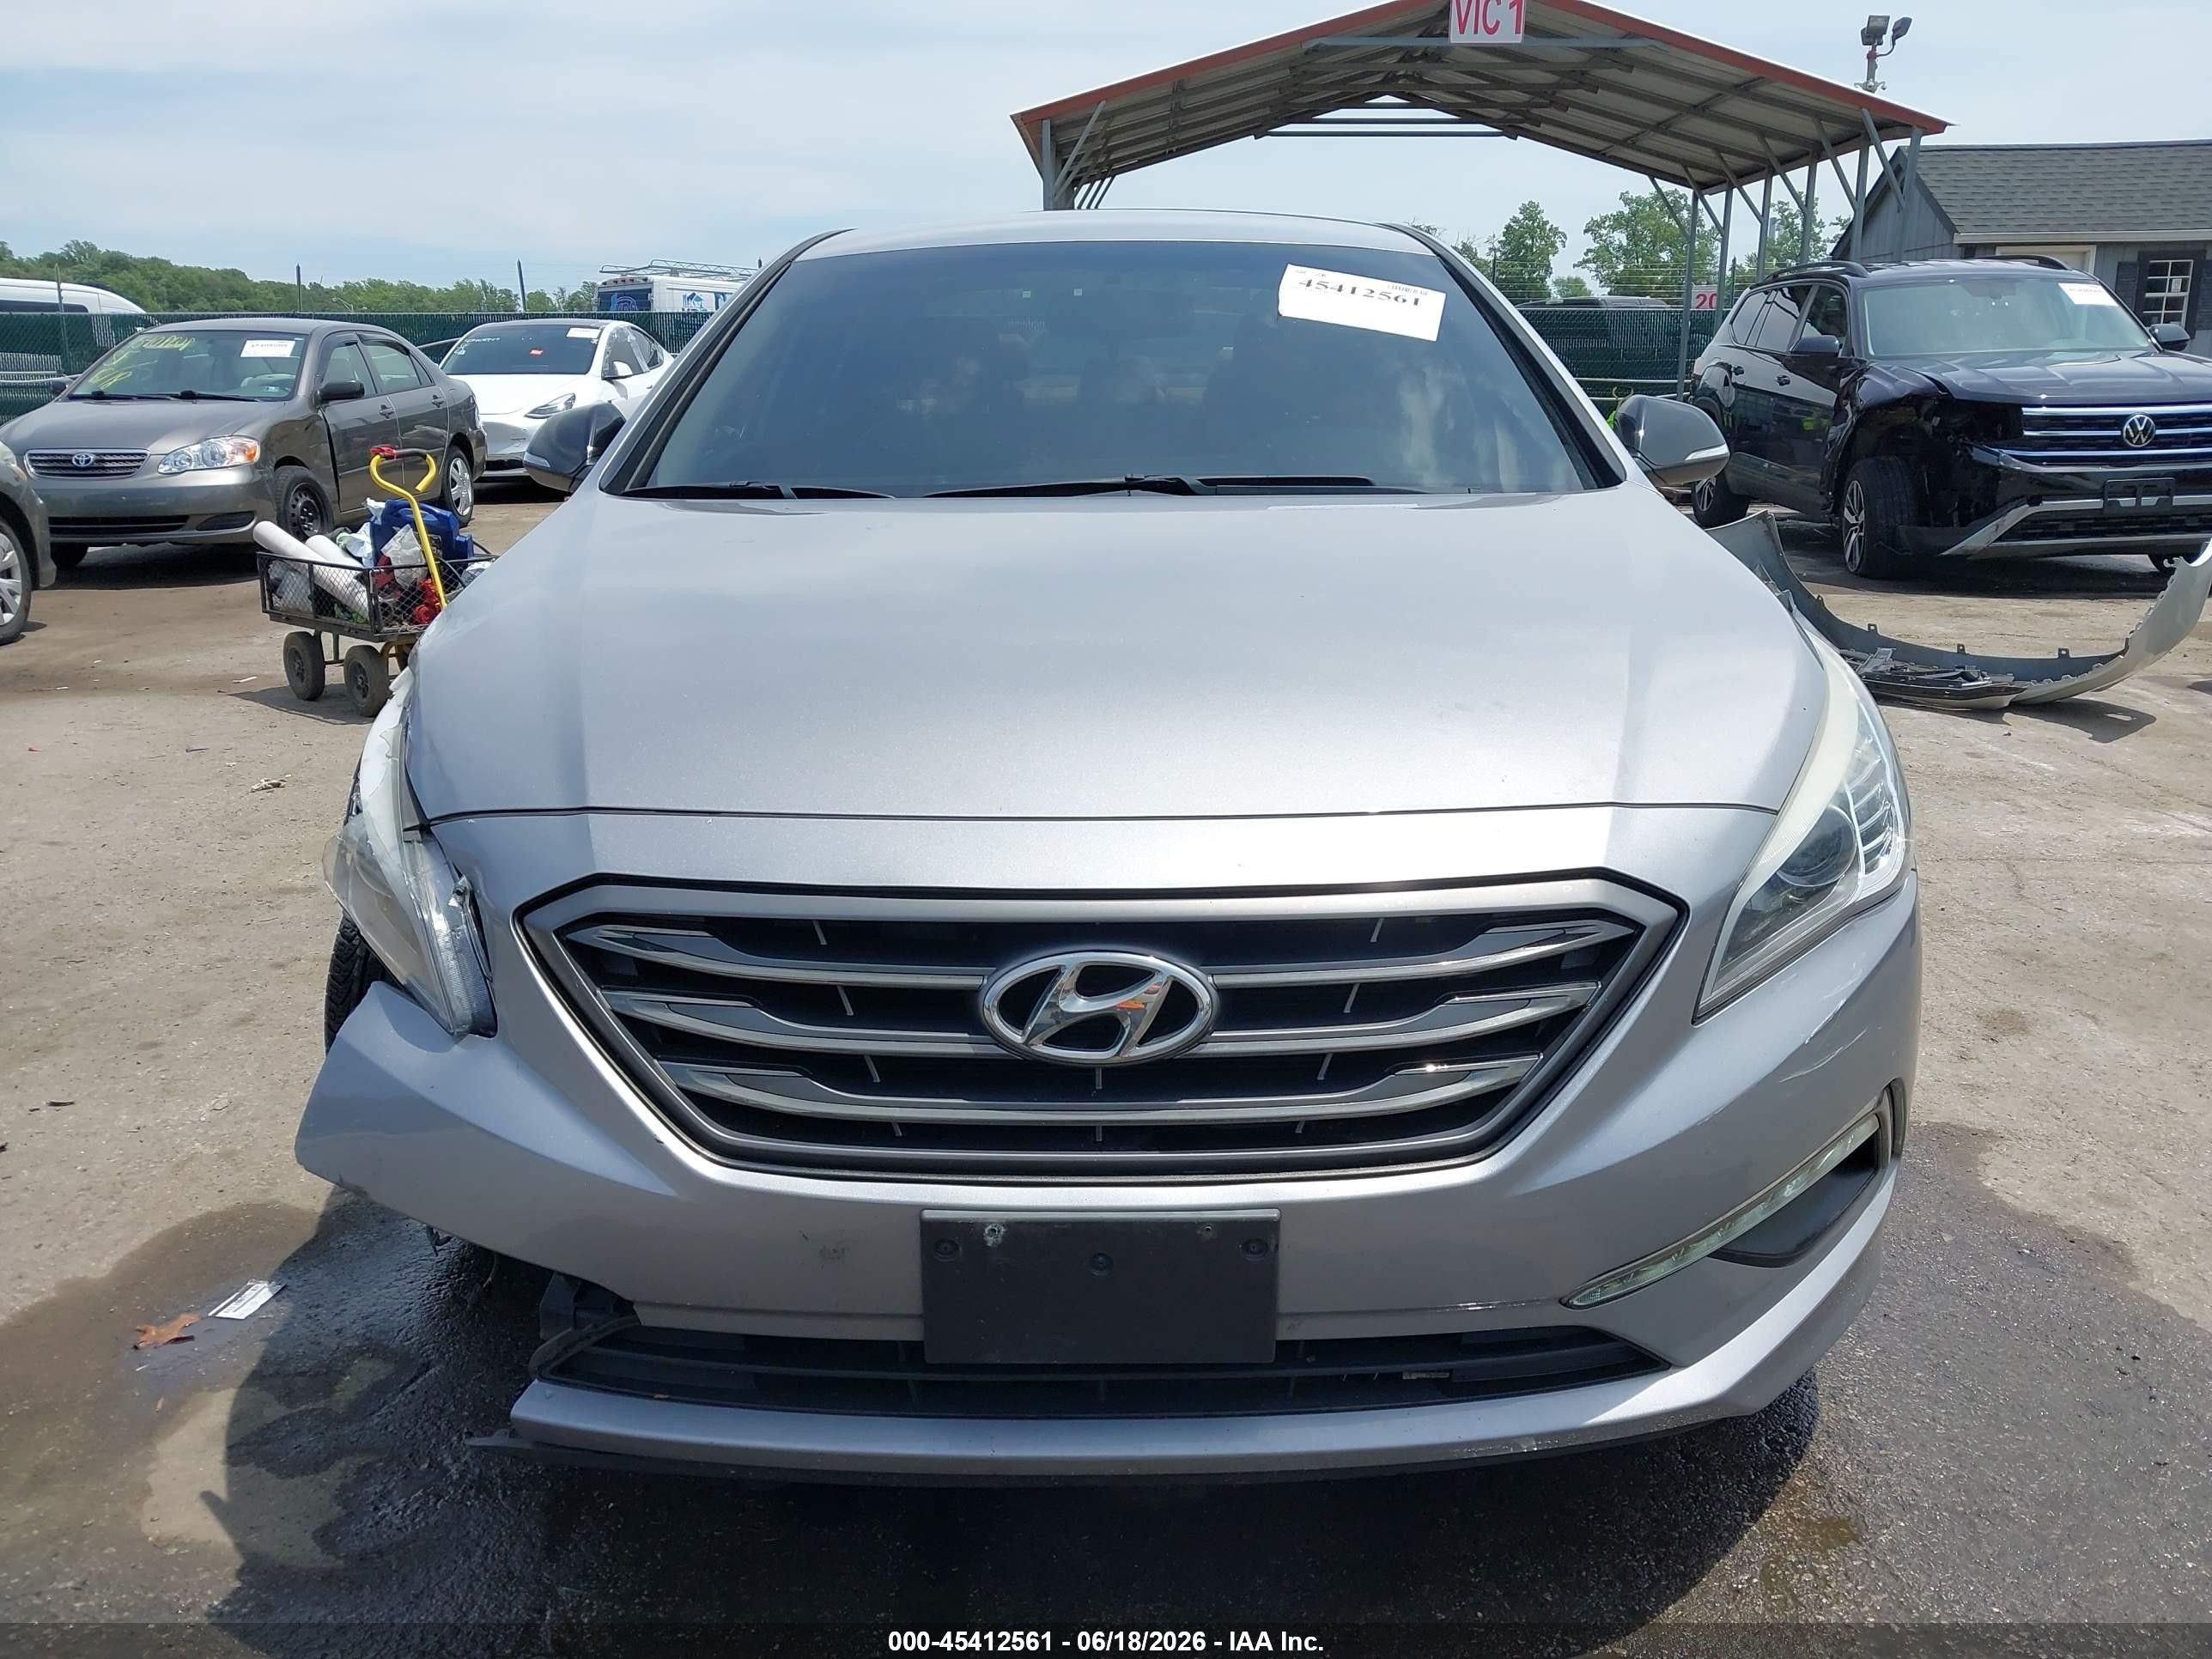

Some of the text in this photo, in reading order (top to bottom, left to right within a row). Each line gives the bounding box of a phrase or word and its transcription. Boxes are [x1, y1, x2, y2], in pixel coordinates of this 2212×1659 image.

[1455, 0, 1523, 34] VIC 1
[1298, 278, 1420, 307] 45412561
